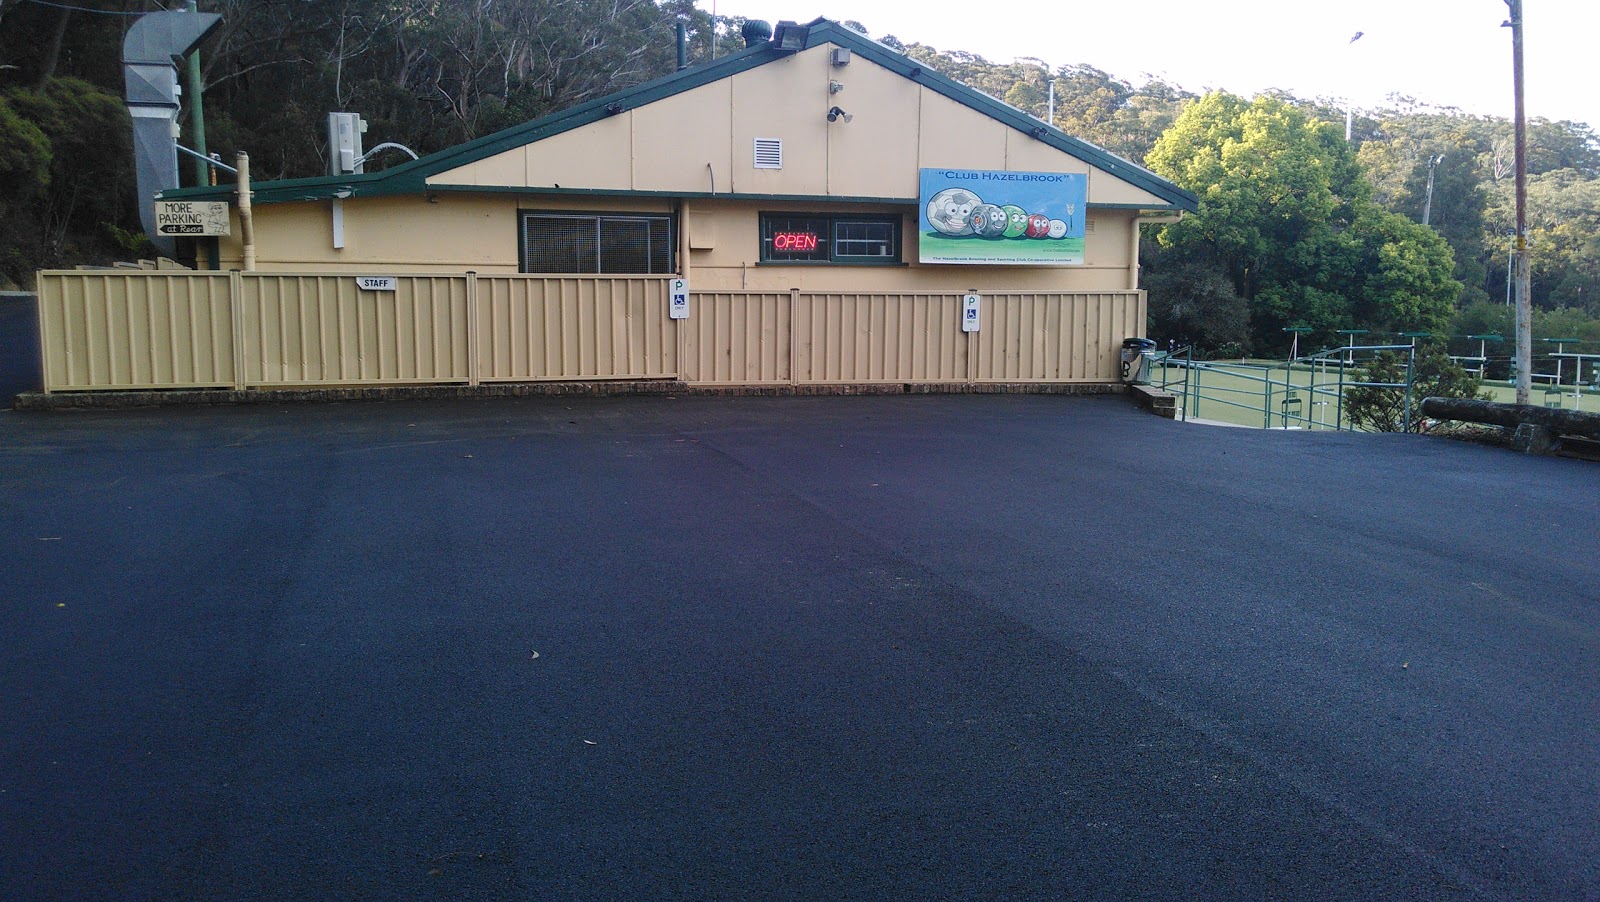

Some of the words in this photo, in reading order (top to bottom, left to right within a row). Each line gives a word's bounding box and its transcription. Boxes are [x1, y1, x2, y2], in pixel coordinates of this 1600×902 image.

[165, 203, 192, 213] MORE
[159, 214, 202, 224] PARKING
[167, 224, 178, 233] at
[180, 225, 203, 233] Rear
[774, 234, 816, 248] OPEN
[364, 279, 388, 287] STAFF
[675, 280, 683, 291] P
[968, 296, 976, 306] P
